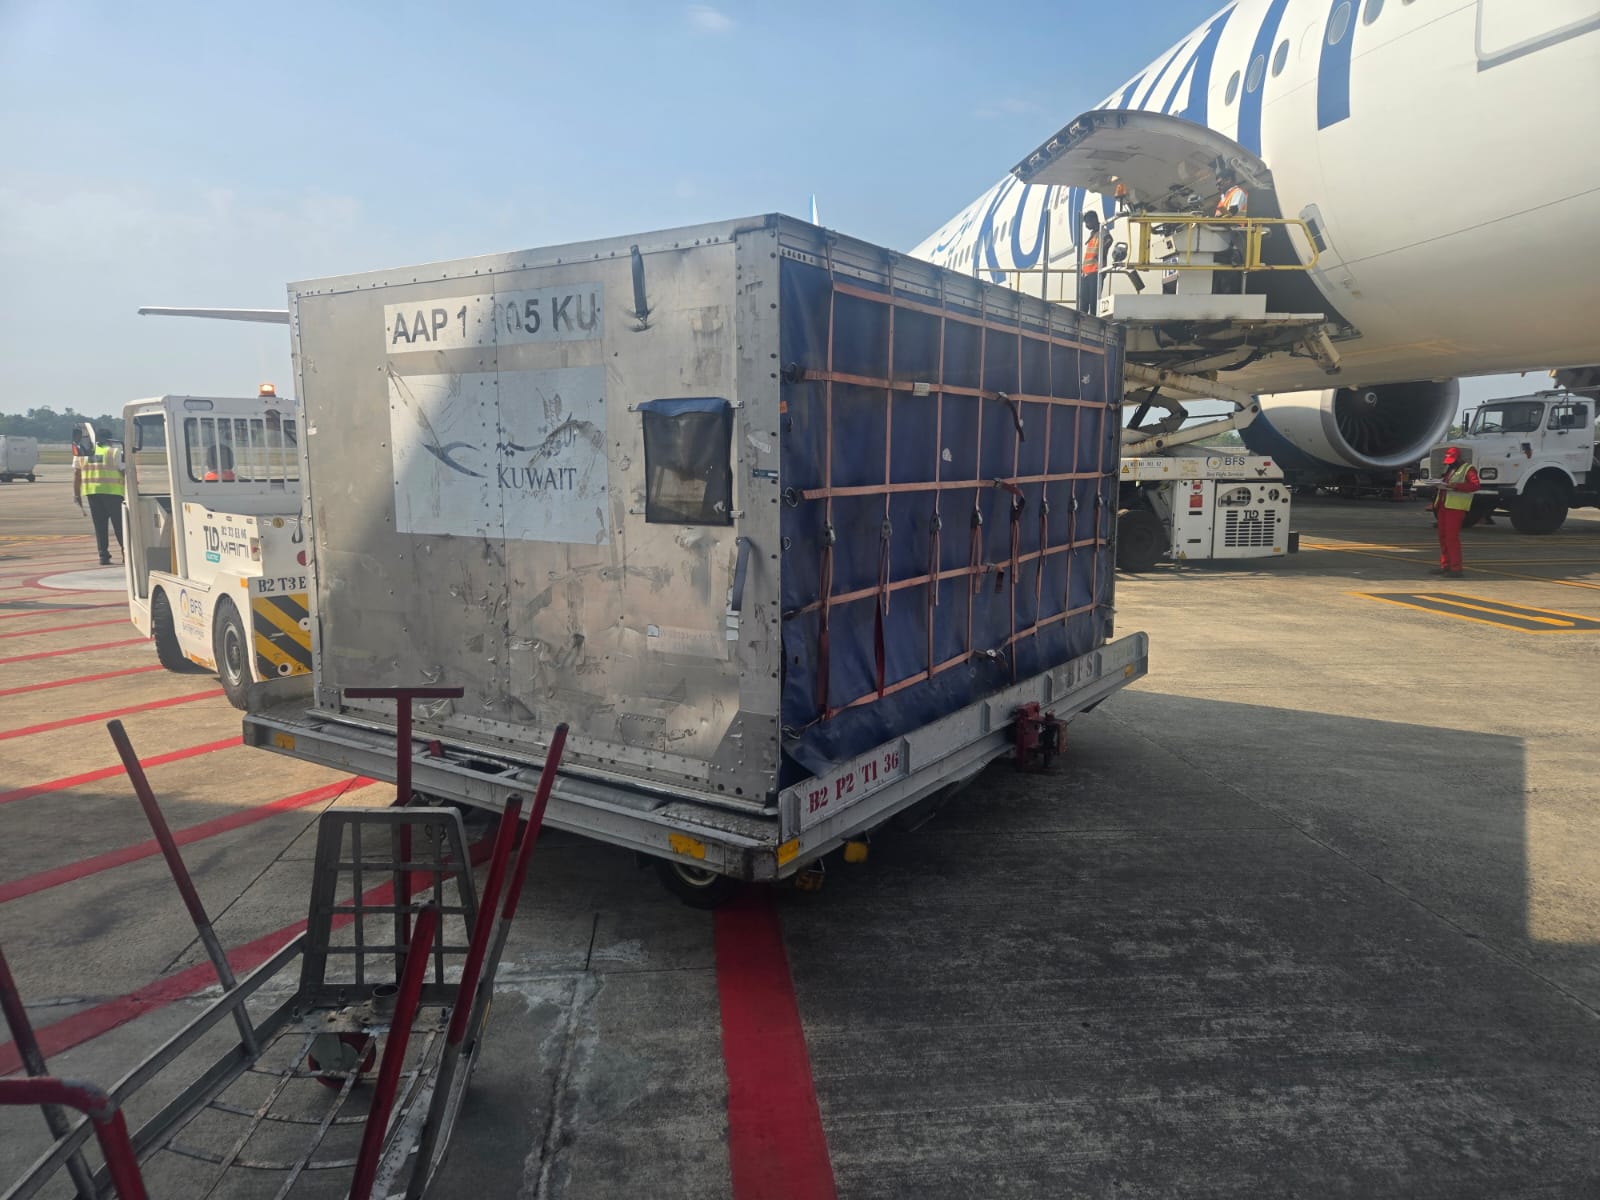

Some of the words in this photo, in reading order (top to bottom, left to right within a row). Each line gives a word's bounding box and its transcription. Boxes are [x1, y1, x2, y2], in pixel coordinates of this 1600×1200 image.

[392, 308, 448, 345] AAP
[552, 293, 597, 333] KU
[1225, 456, 1245, 466] BFS
[497, 467, 577, 490] KUWAIT
[1243, 510, 1259, 519] TLD
[203, 525, 219, 551] TLD
[258, 579, 275, 593] B2
[278, 577, 296, 591] T3
[190, 598, 203, 617] BFS
[808, 786, 829, 814] B2
[836, 773, 854, 801] P2
[884, 752, 899, 774] 36
